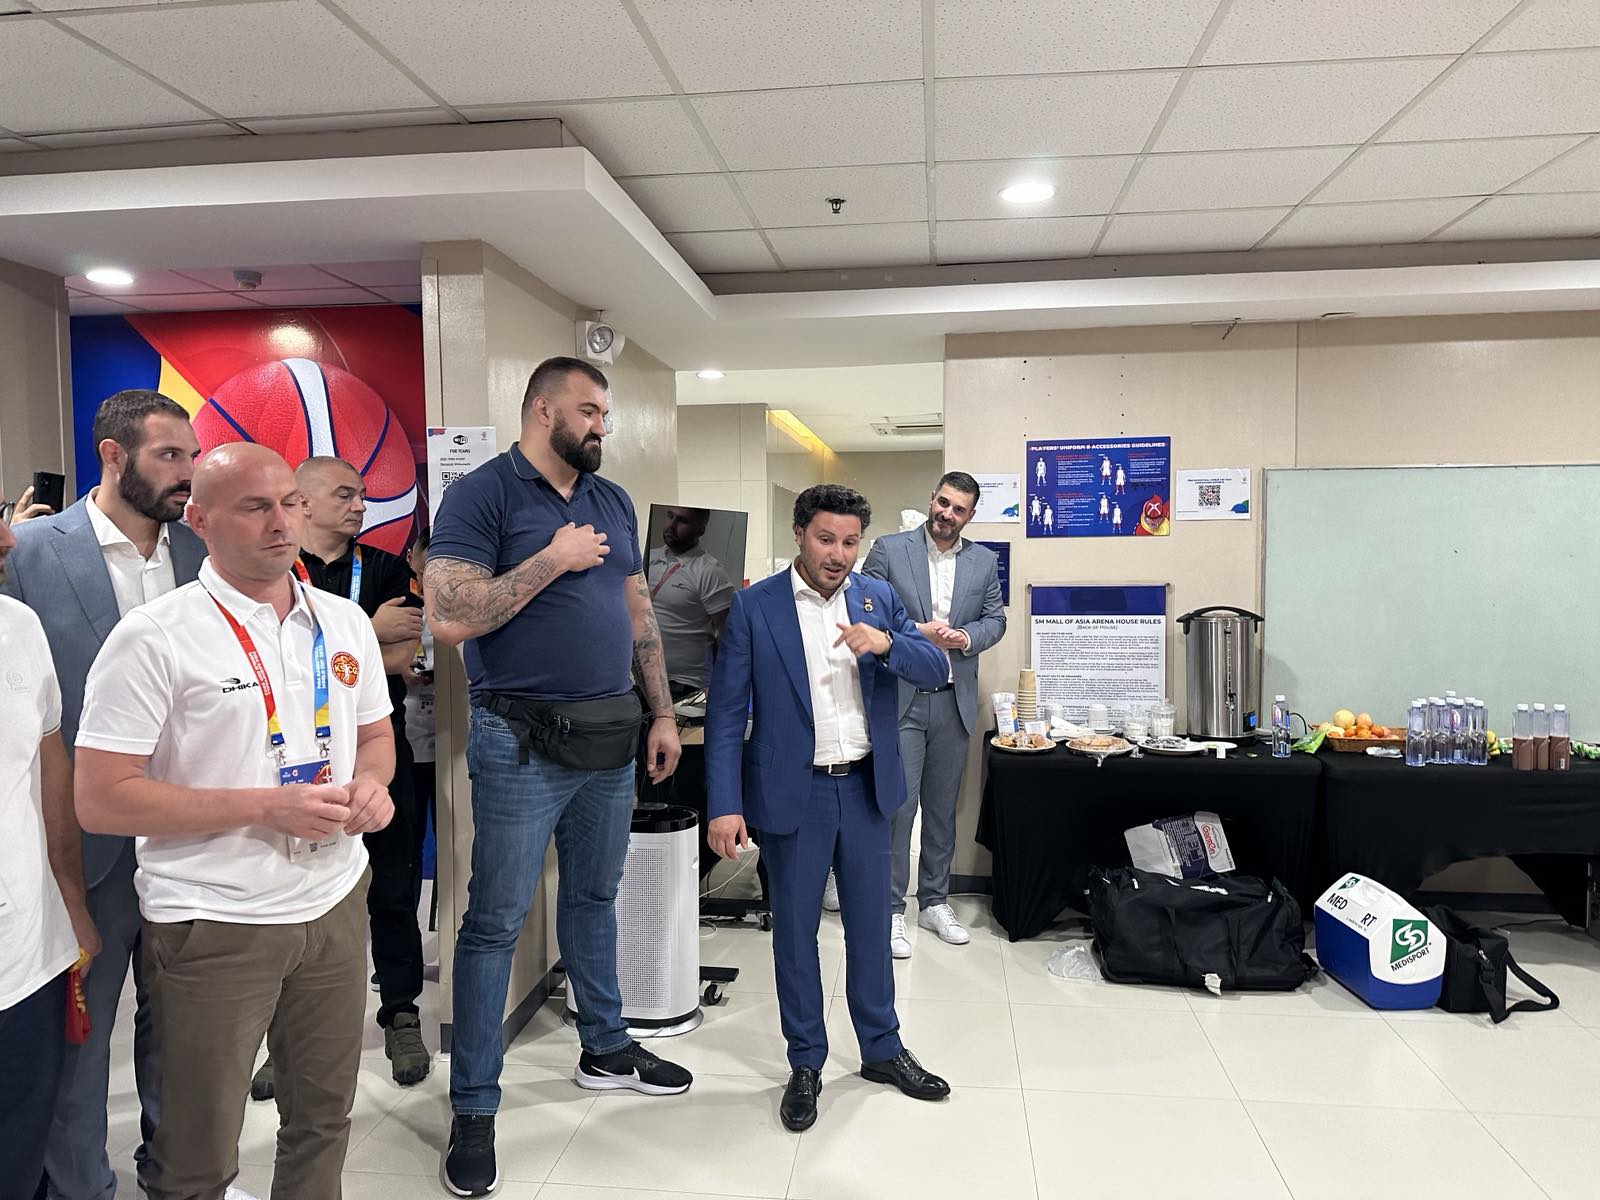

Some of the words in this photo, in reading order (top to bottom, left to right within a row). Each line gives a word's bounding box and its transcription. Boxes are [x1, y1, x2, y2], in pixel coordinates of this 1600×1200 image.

[1326, 893, 1348, 910] MED
[1360, 913, 1377, 928] RT
[1390, 947, 1430, 972] MEDISPORT
